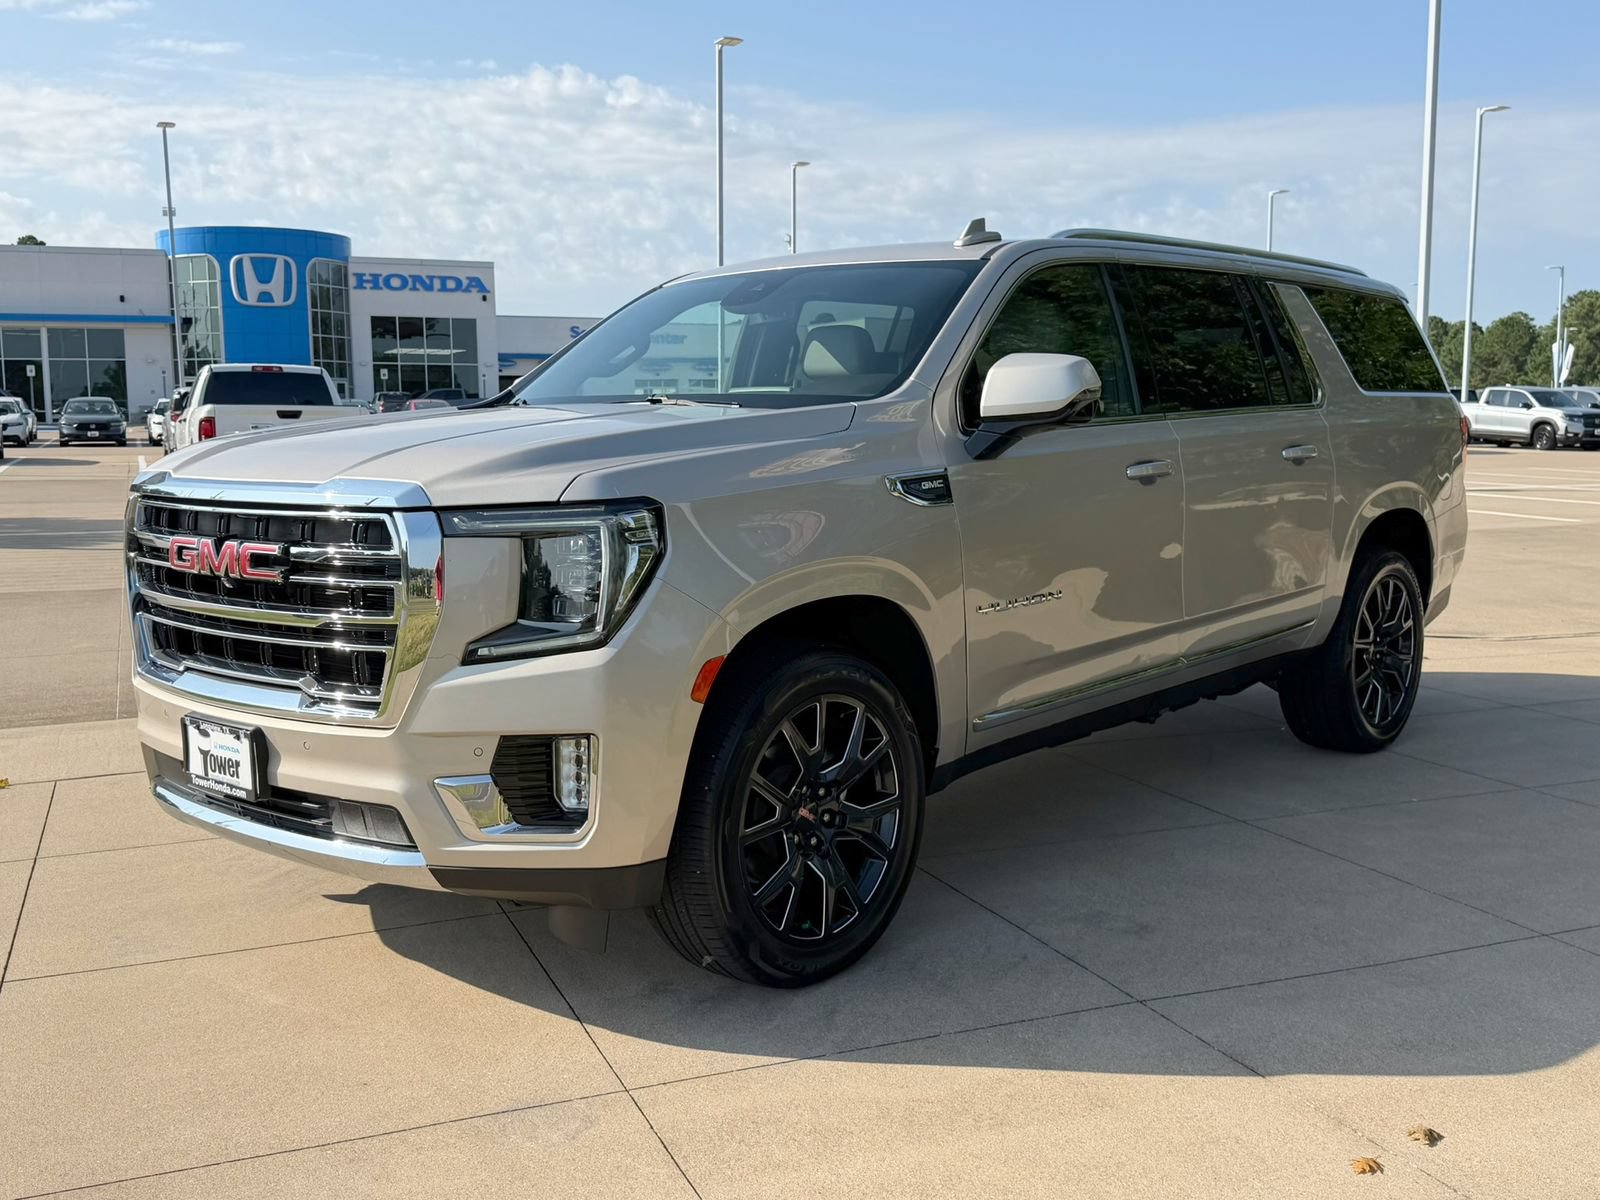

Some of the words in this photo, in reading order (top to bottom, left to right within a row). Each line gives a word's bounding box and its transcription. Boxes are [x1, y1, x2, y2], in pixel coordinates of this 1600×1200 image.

[352, 272, 491, 294] HONDA
[922, 479, 945, 490] GMC
[168, 535, 283, 582] GMC
[976, 589, 1063, 614] YUKON
[218, 743, 241, 755] HONDA
[197, 745, 241, 780] Tower
[190, 774, 247, 799] TowerHonda.com
